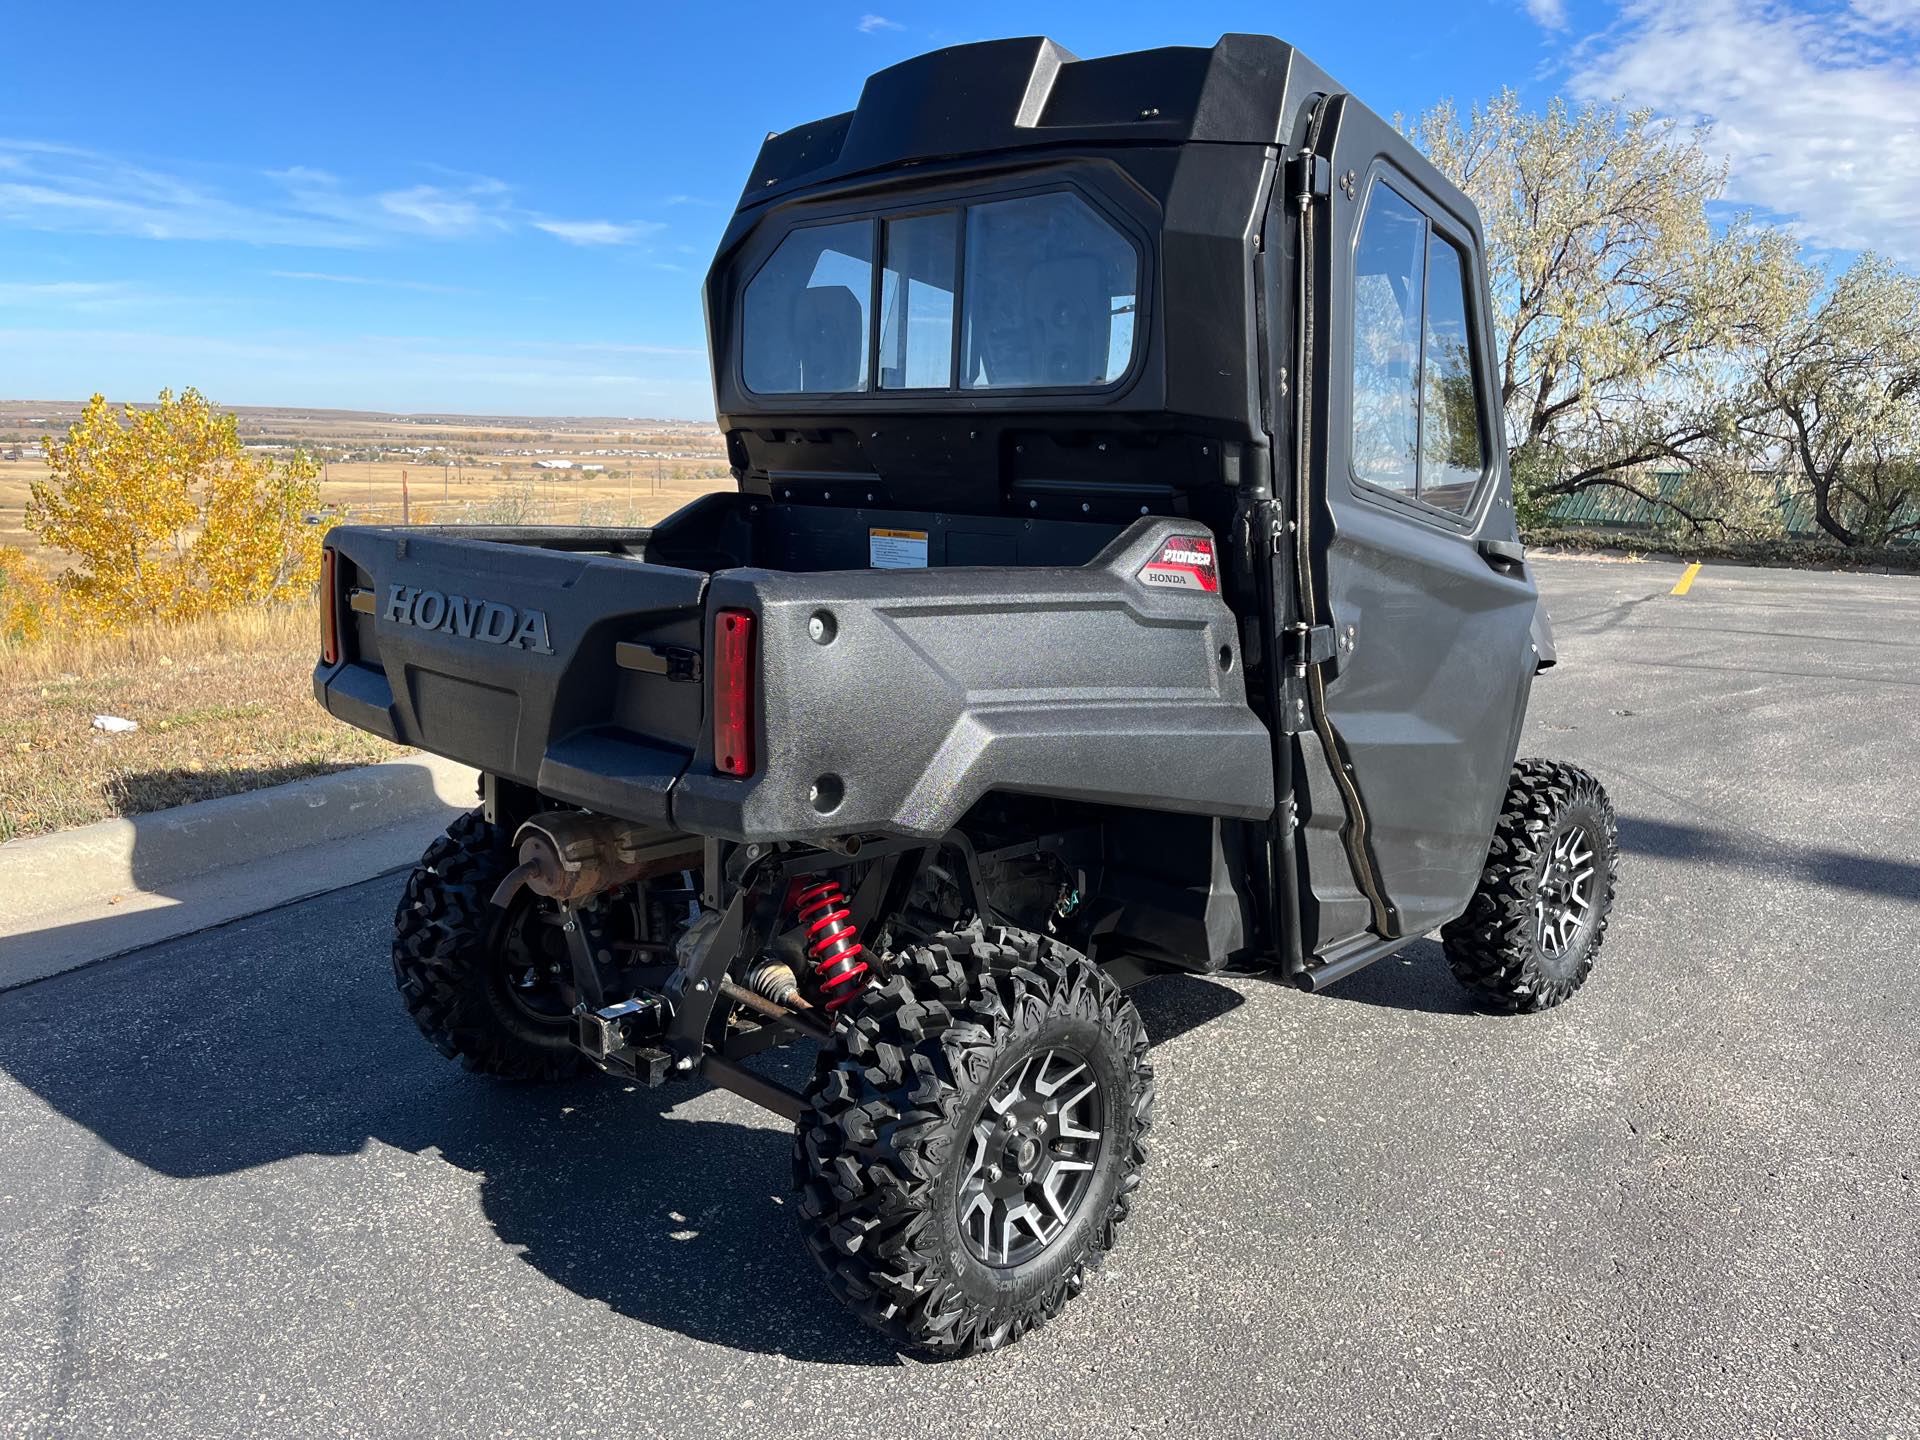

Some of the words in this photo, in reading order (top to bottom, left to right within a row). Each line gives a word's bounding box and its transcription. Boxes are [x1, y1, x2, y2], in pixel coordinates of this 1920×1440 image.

[1164, 550, 1211, 566] PIONEER
[1149, 573, 1187, 584] HONDA
[384, 583, 554, 655] HONDA
